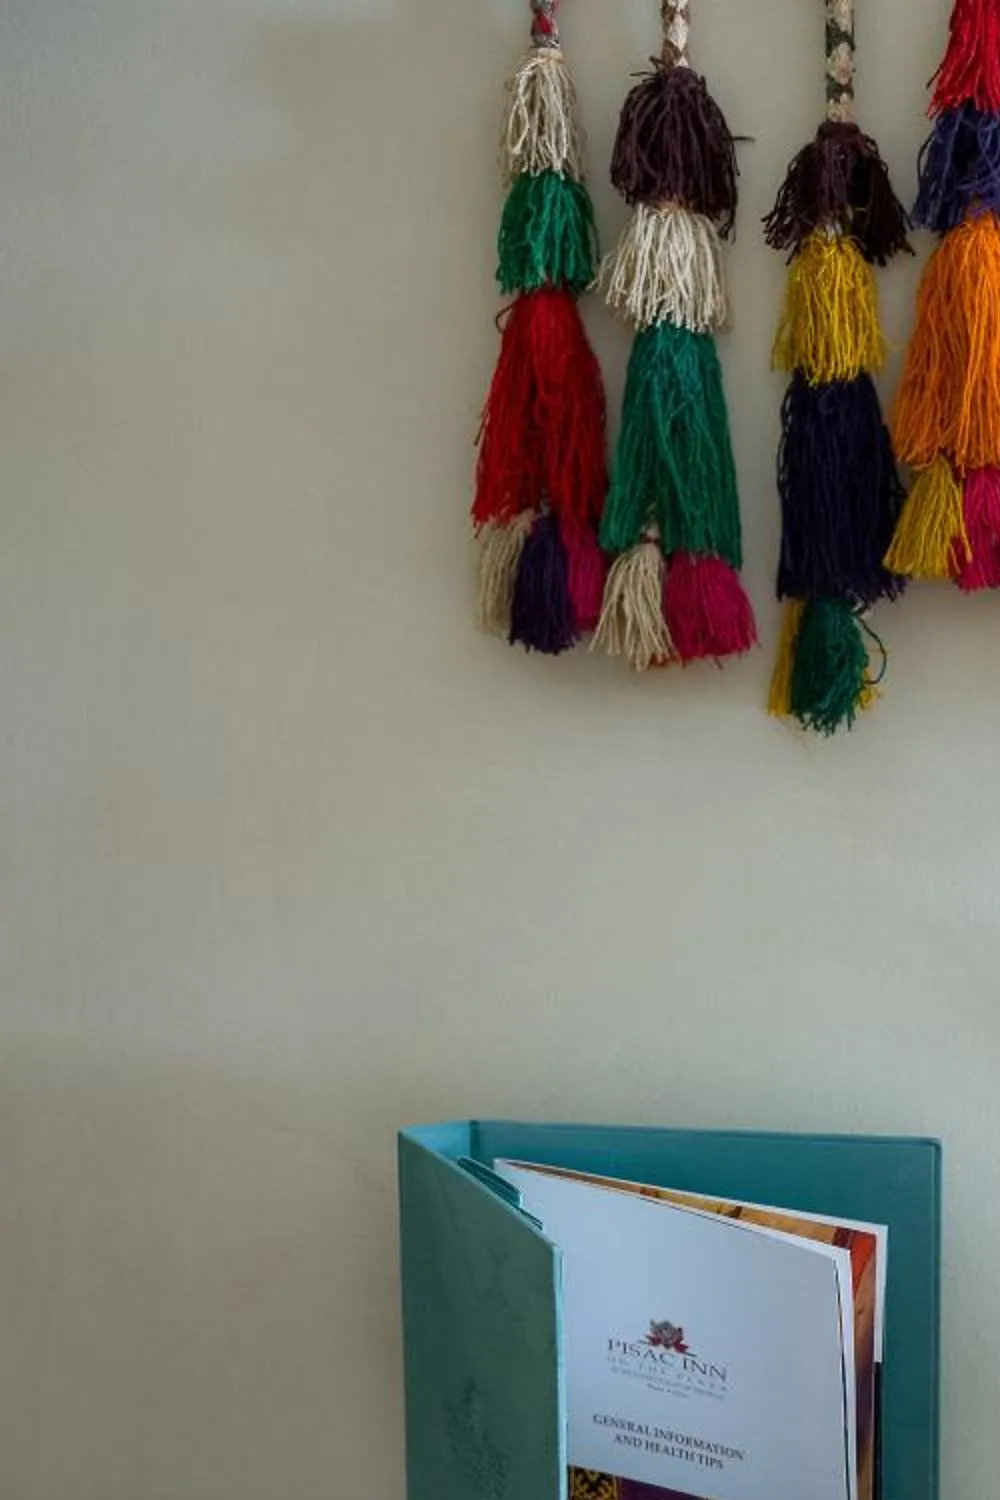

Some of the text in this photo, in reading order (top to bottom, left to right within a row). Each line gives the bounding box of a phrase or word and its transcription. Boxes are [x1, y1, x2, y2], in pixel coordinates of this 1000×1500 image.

[608, 1338, 674, 1367] PISAC
[683, 1357, 727, 1382] INN
[592, 1413, 744, 1460] GENERAL INFORMATION
[614, 1435, 723, 1469] AND HEALTH TIPS
